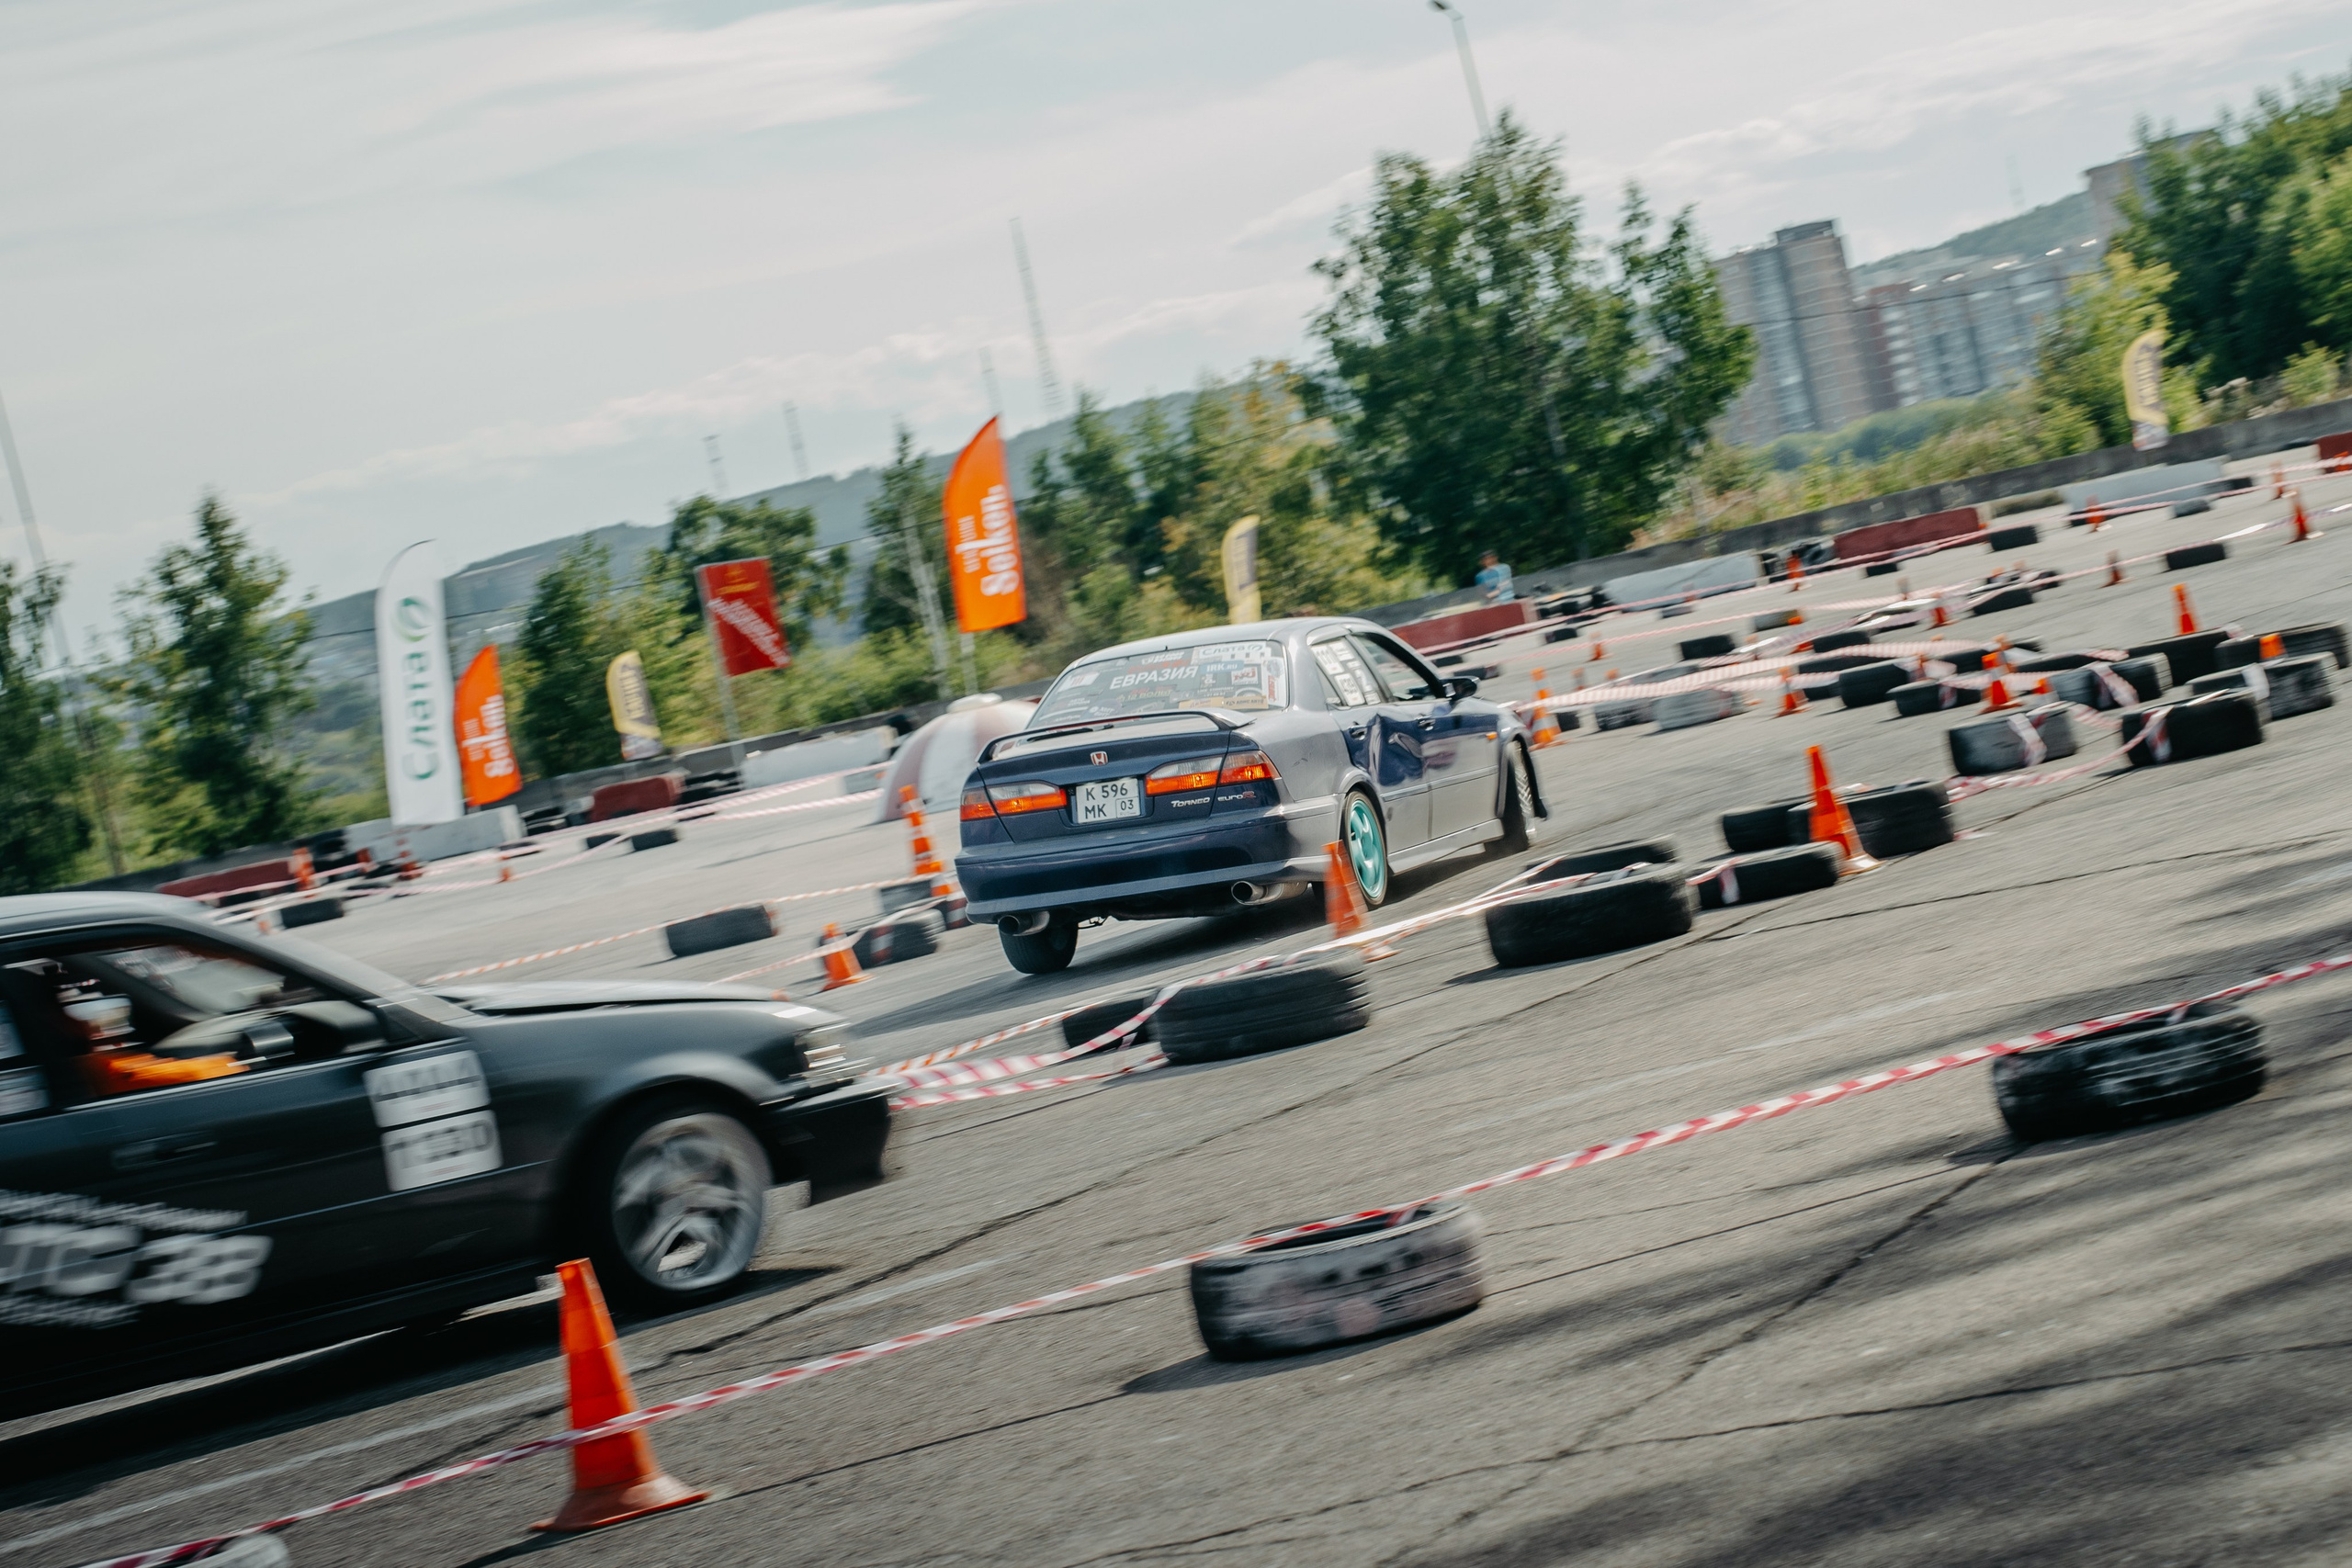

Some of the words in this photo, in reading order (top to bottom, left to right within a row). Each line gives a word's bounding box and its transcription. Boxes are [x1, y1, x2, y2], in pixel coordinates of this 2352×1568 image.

[1202, 645, 1245, 656] Слата
[1109, 665, 1199, 690] ЕВРАЗИЯ
[1101, 783, 1128, 799] 596
[1120, 799, 1134, 811] 03
